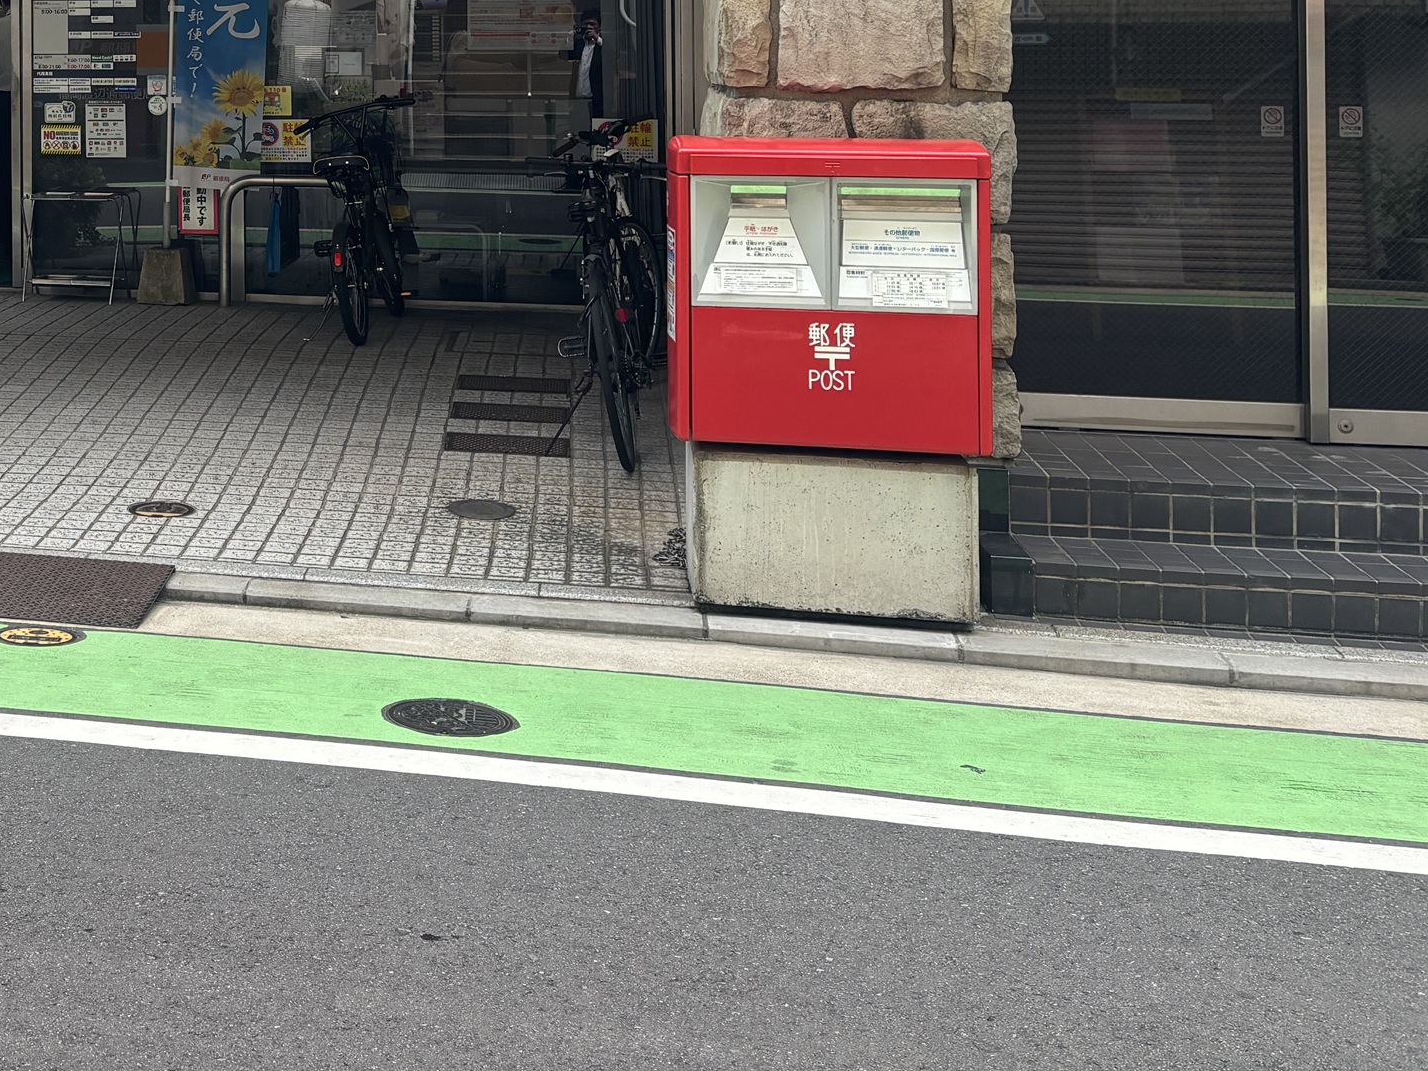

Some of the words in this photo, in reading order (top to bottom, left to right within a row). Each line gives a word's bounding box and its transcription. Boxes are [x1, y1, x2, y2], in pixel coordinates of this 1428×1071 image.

[43, 131, 55, 140] NO
[628, 136, 652, 147] 禁止
[183, 187, 191, 221] 郵便局長
[808, 322, 855, 348] 郵便
[808, 369, 855, 391] POST
